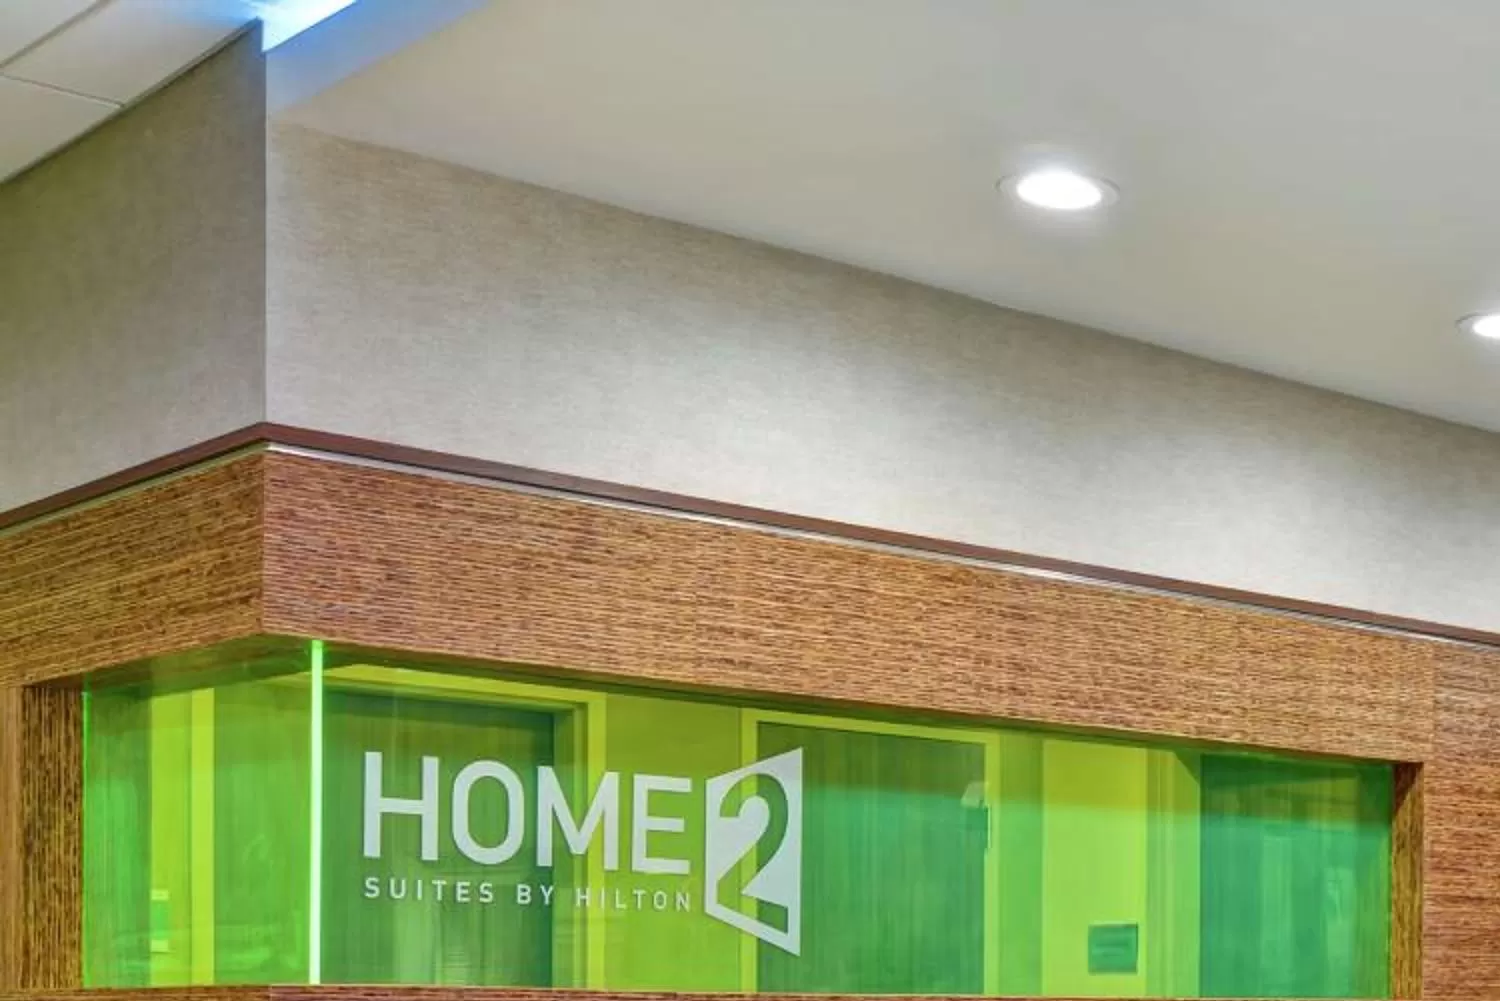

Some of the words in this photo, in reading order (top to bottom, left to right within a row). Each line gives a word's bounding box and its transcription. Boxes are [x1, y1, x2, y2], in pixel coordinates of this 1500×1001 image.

[363, 751, 693, 875] HOME
[714, 769, 792, 938] 2
[364, 876, 493, 902] SUITES
[516, 883, 554, 905] BY
[575, 888, 691, 912] HILTON
